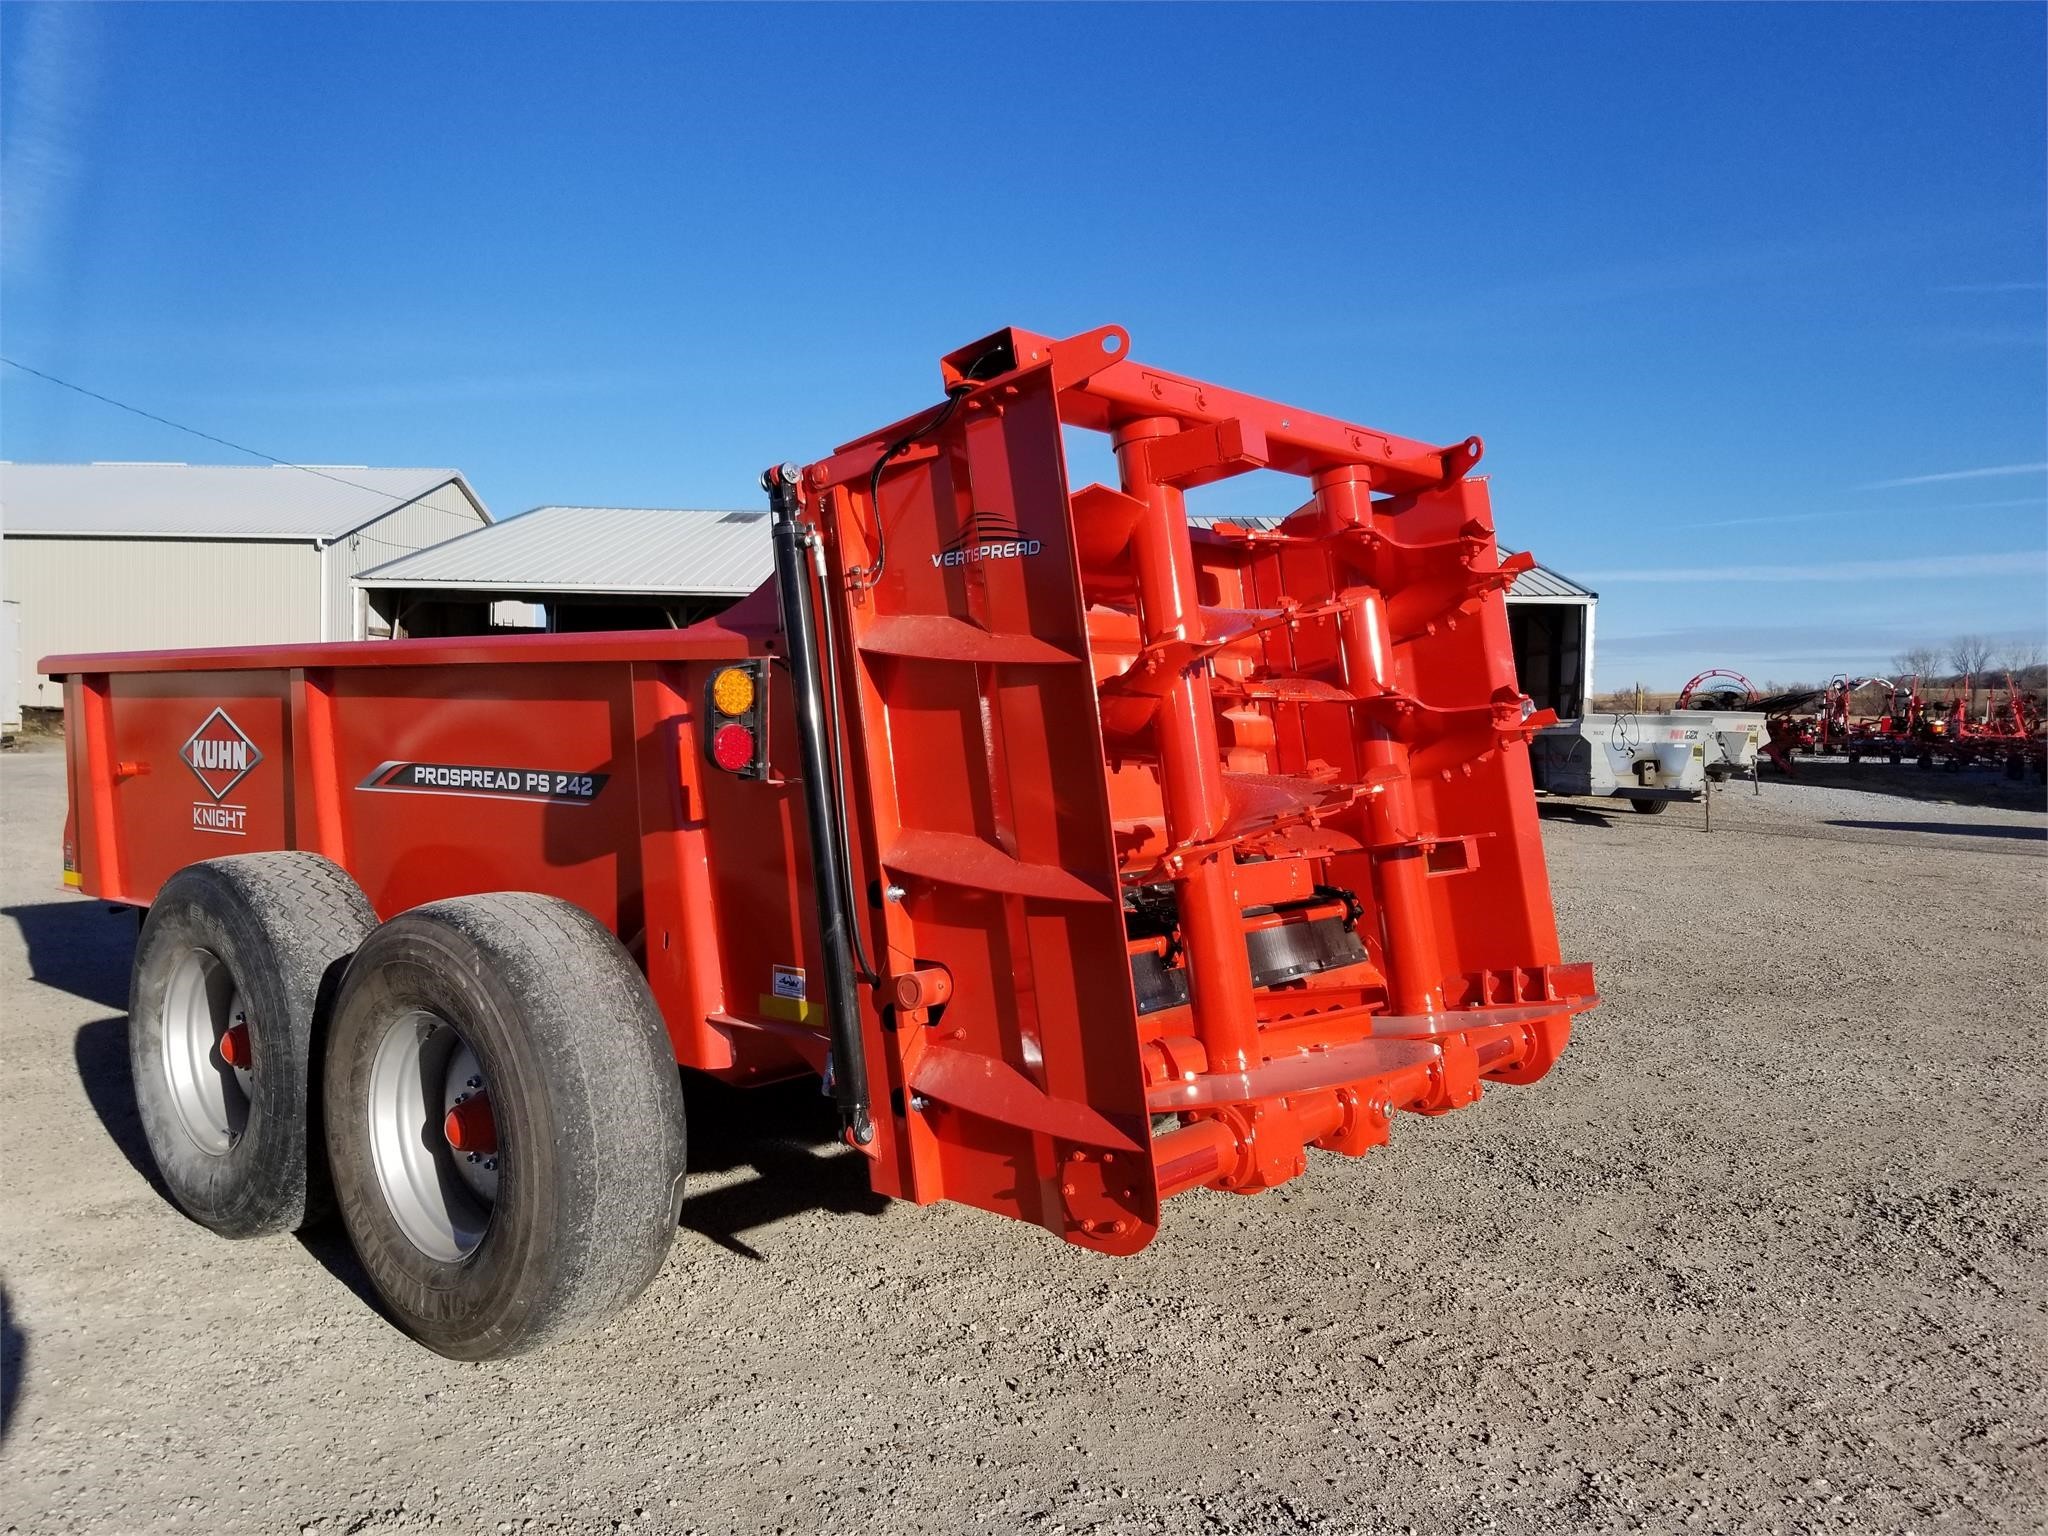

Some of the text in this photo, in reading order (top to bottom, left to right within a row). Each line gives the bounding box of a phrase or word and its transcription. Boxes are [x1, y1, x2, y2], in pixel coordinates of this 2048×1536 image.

[931, 540, 1041, 567] VERTISPREAD
[192, 740, 247, 770] KUHN
[414, 766, 593, 795] PROSPREAD PS 242
[193, 807, 246, 830] KNIGHT
